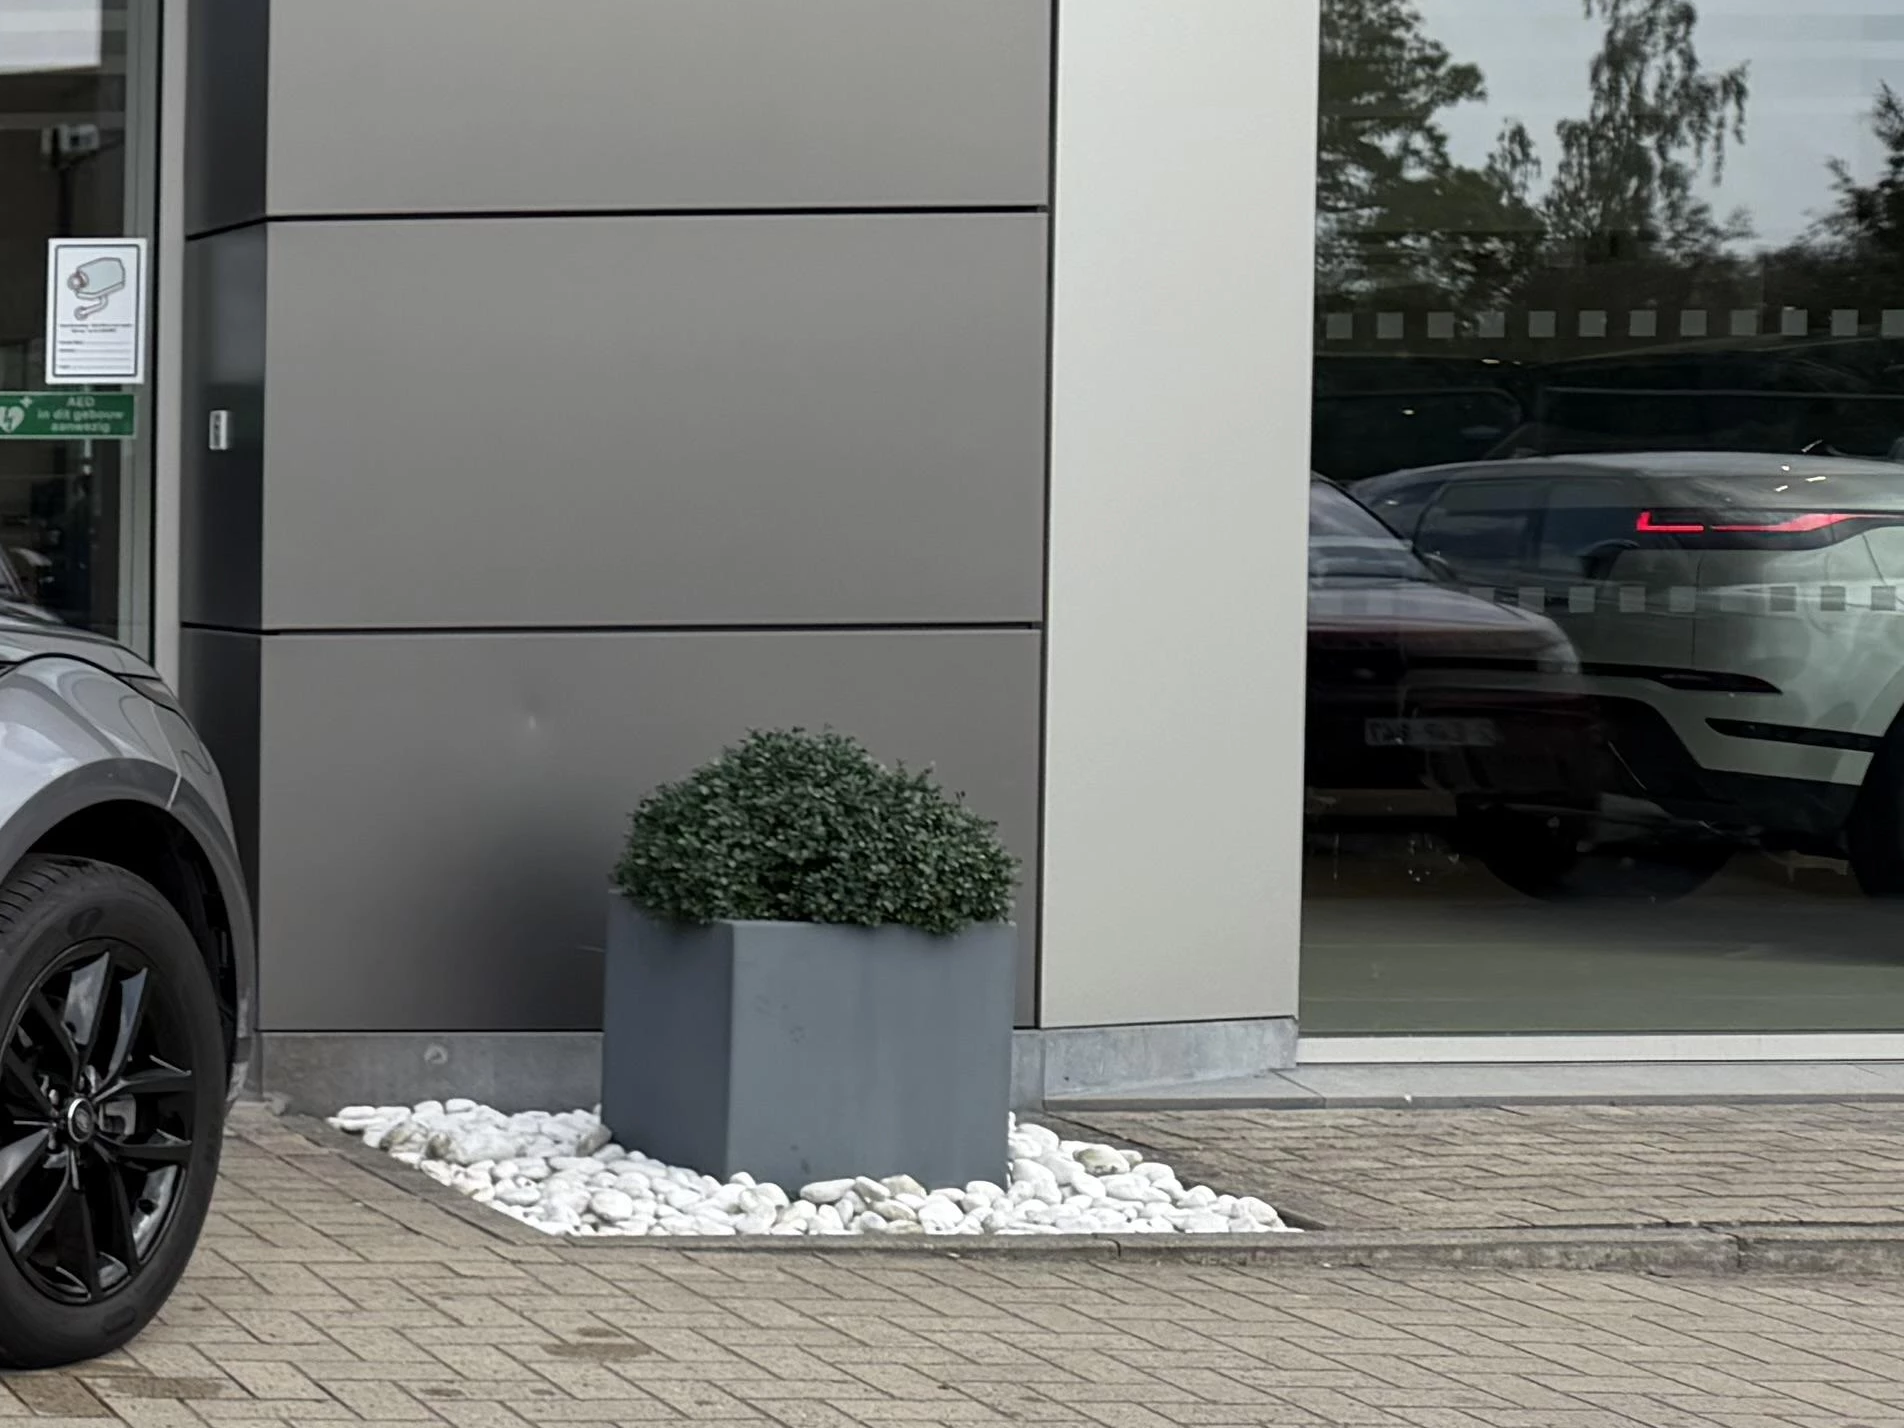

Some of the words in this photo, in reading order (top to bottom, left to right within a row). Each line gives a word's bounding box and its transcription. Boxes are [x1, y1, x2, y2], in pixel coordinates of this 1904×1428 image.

[66, 396, 96, 408] AED
[53, 409, 71, 419] dit
[73, 409, 124, 421] gebouw
[50, 422, 111, 433] aanwezig
